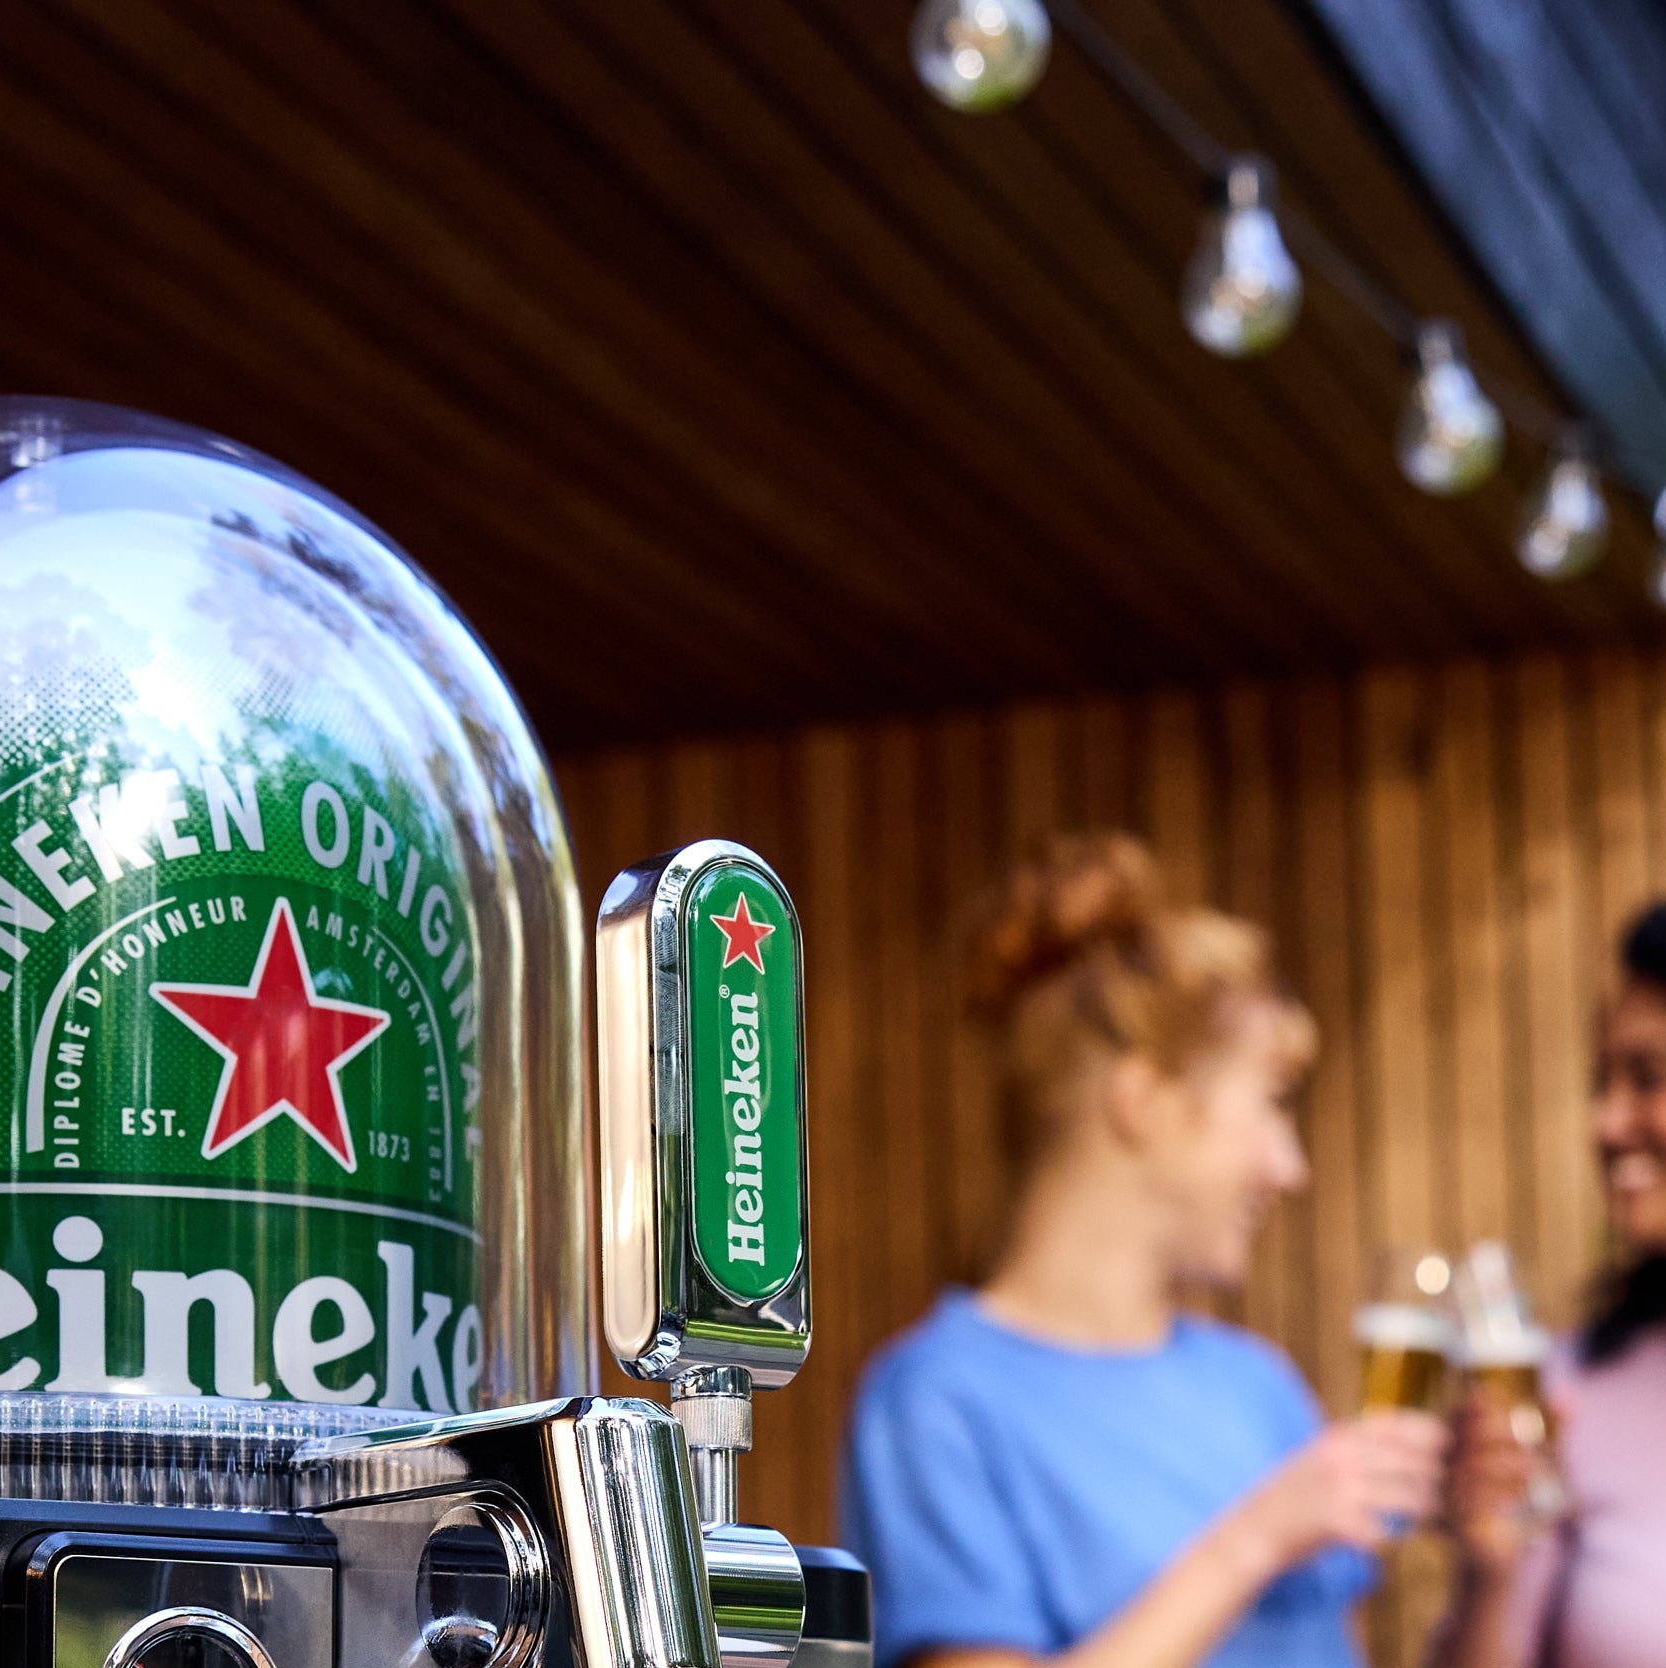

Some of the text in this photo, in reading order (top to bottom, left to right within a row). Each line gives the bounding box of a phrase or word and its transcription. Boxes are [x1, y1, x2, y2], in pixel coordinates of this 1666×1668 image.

[53, 1020, 91, 1169] DIPLOME
[76, 896, 247, 1008] D'HONNEUR
[306, 904, 431, 1046] AMSTERDAM
[121, 1107, 411, 1162] EST. 1873
